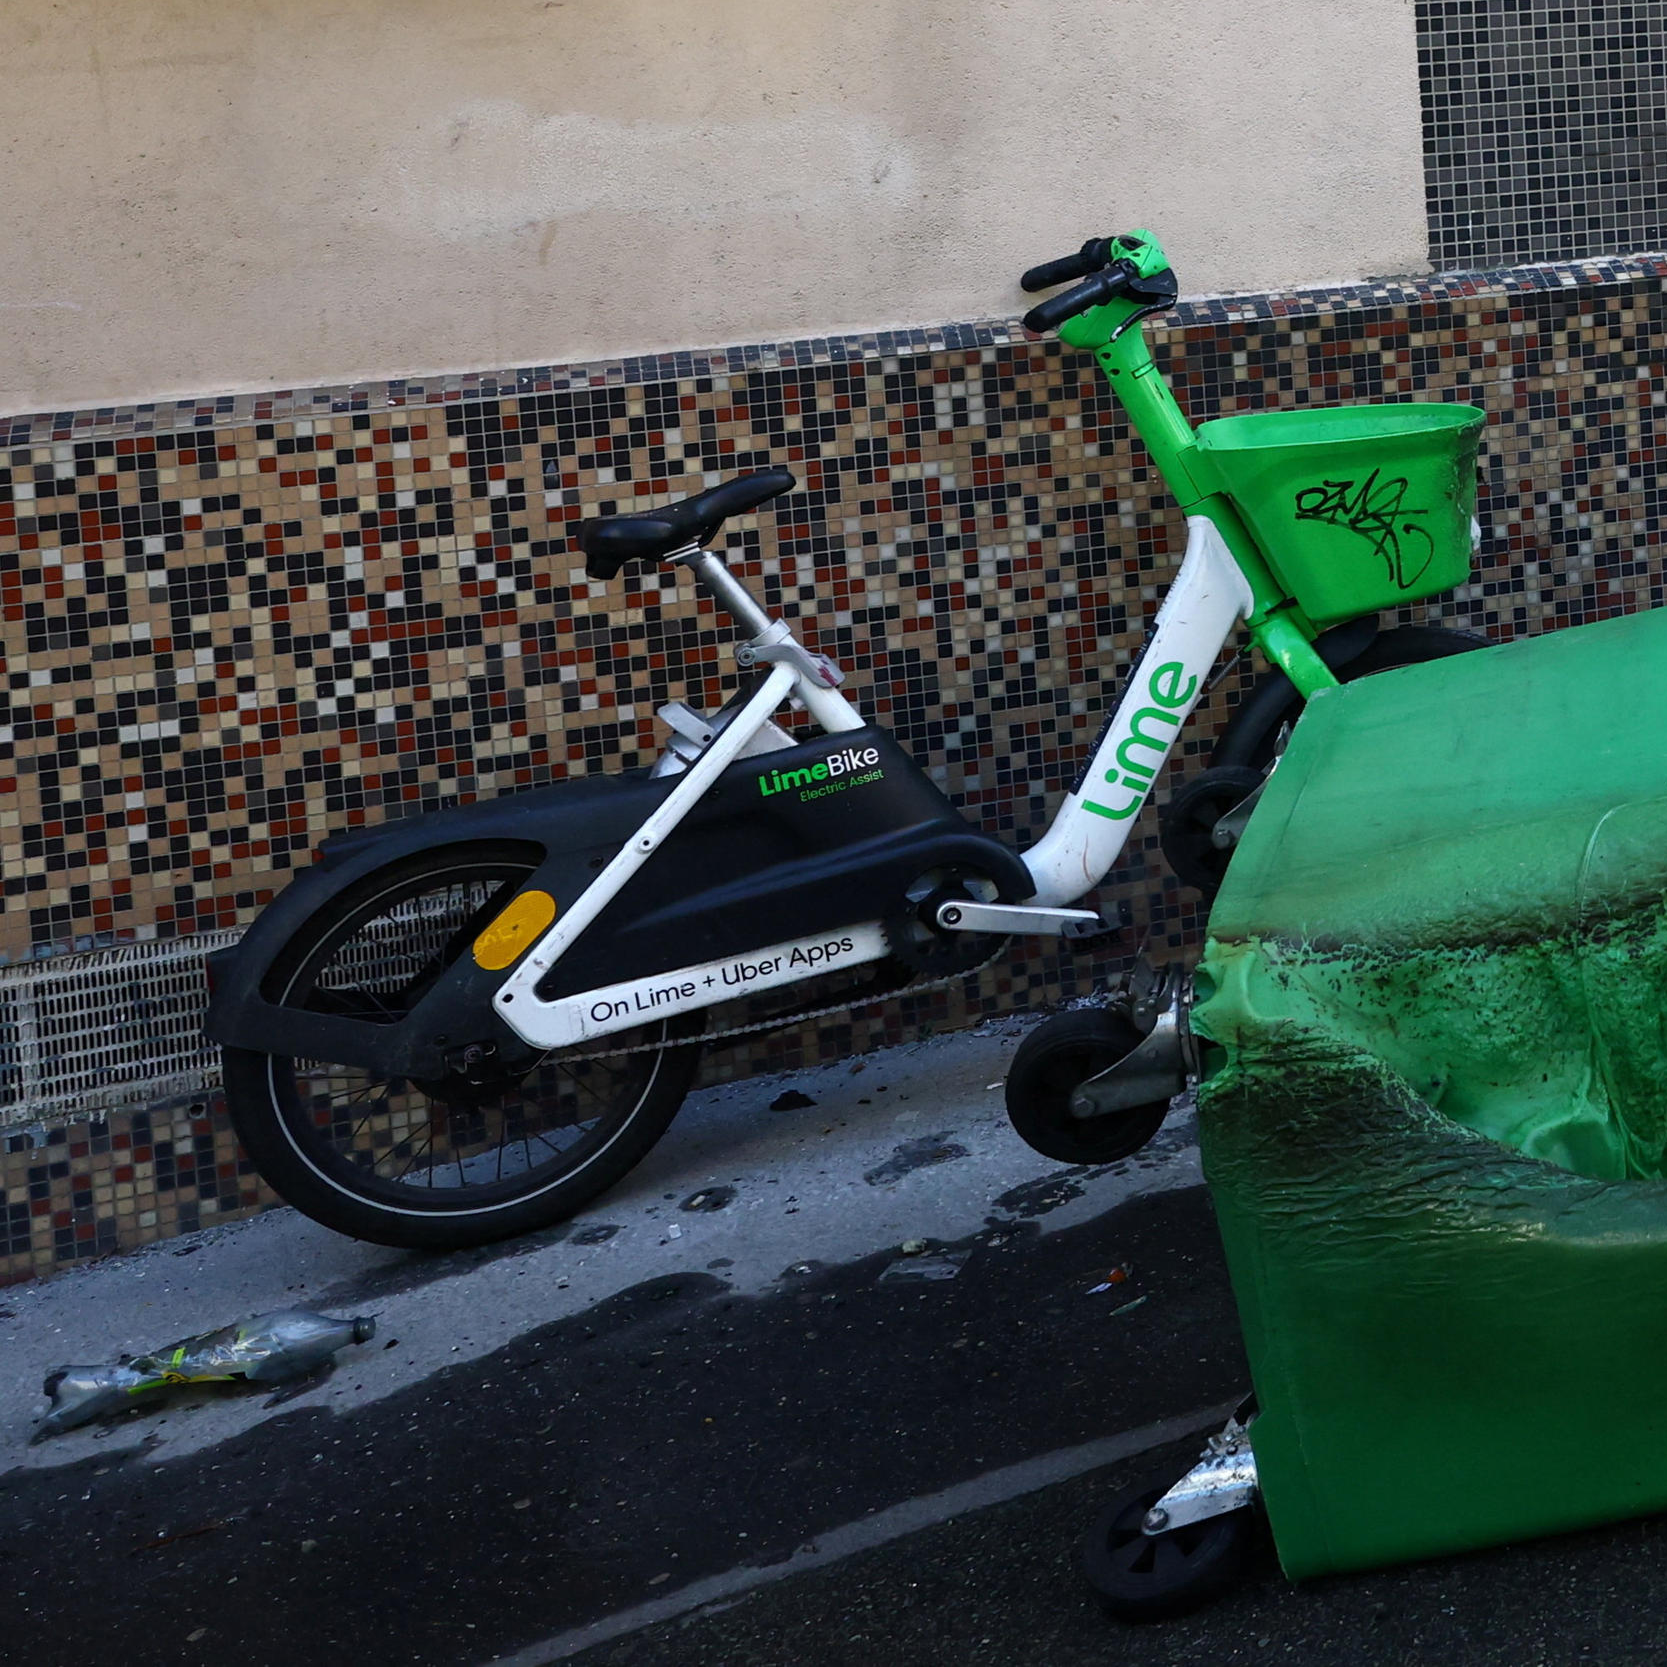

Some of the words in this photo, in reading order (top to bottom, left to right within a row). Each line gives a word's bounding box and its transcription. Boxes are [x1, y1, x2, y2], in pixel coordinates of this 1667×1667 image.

[759, 748, 879, 797] LimeBike
[1081, 661, 1197, 820] Lime
[800, 781, 846, 802] Electric
[849, 769, 884, 788] Assist
[591, 1000, 629, 1022] On
[635, 981, 696, 1010] Lime
[703, 975, 716, 988] +
[721, 956, 782, 986] Uber
[789, 936, 854, 969] Apps
